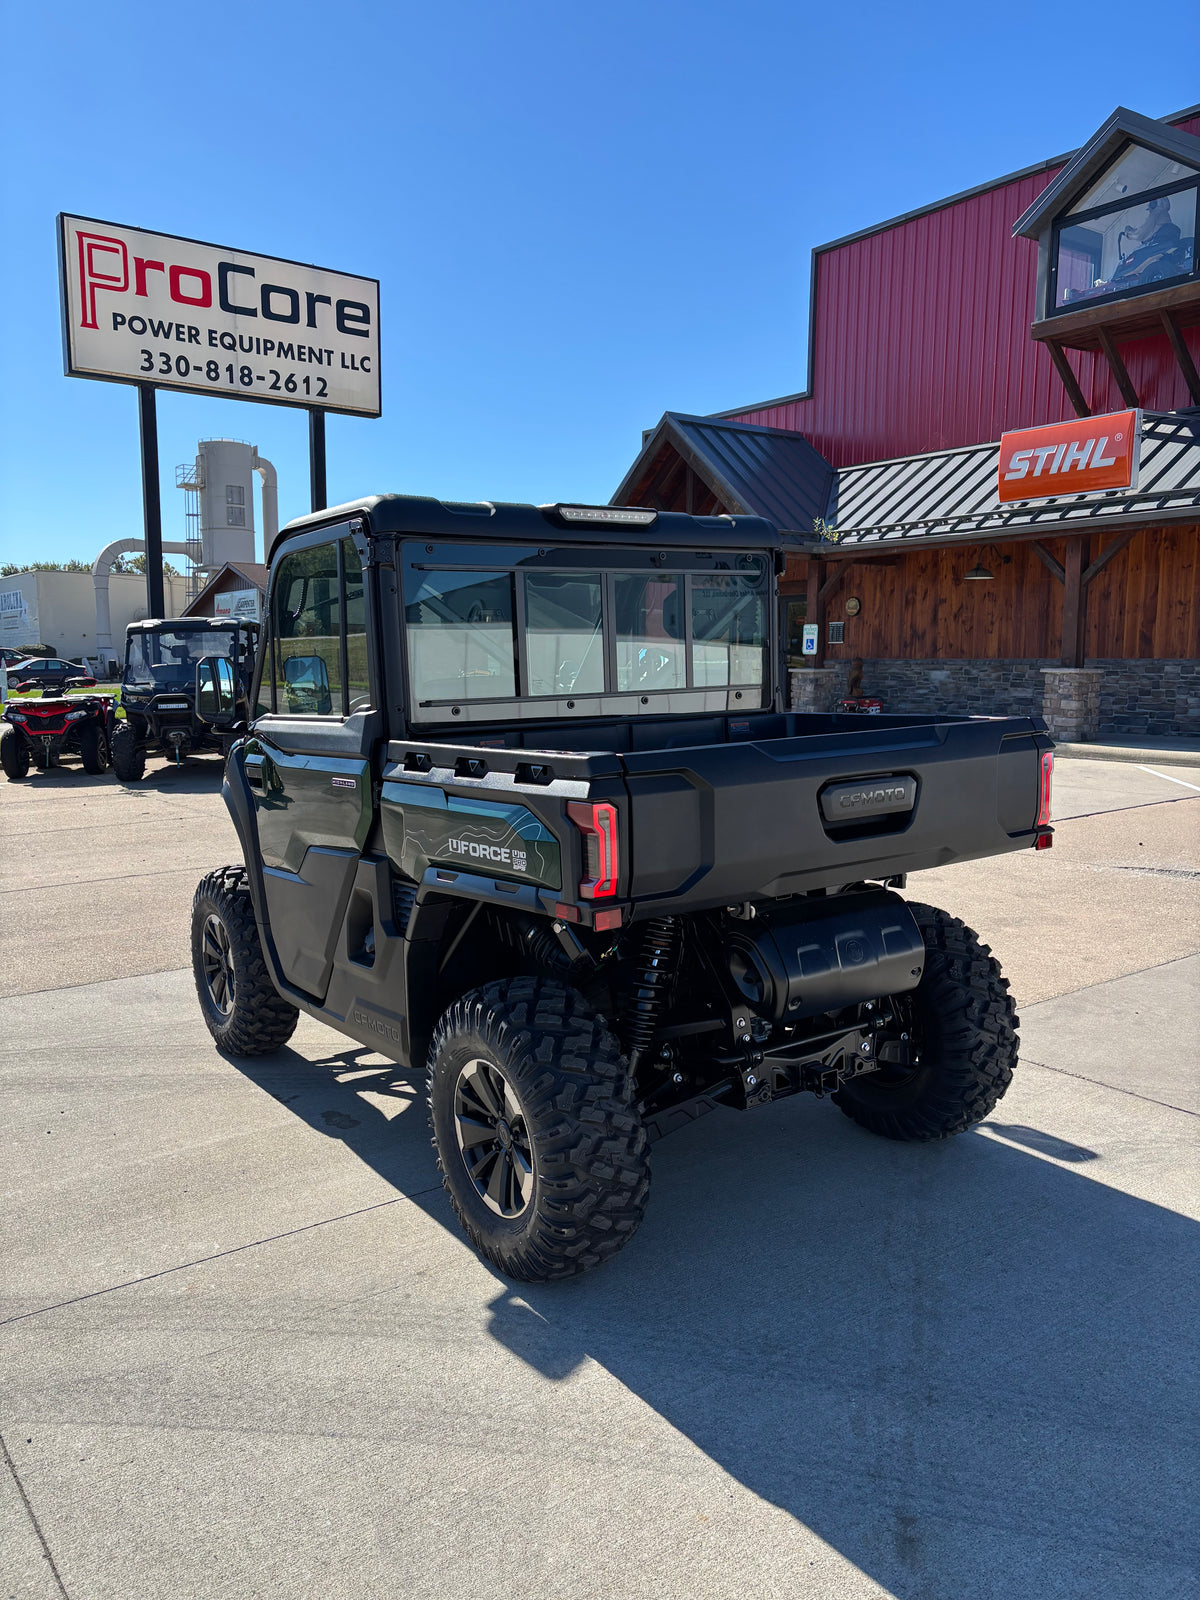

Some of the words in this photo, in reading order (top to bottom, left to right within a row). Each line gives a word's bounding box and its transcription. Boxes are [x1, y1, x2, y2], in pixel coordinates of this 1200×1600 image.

[75, 230, 371, 338] ProCore
[112, 311, 202, 345] POWER
[208, 328, 334, 367] EQUIPMENT
[341, 348, 371, 373] LLC
[140, 349, 328, 398] 330-818-2612
[1004, 436, 1116, 481] STIHL
[840, 787, 905, 808] CFMOTO
[353, 1010, 400, 1042] CFMOTO
